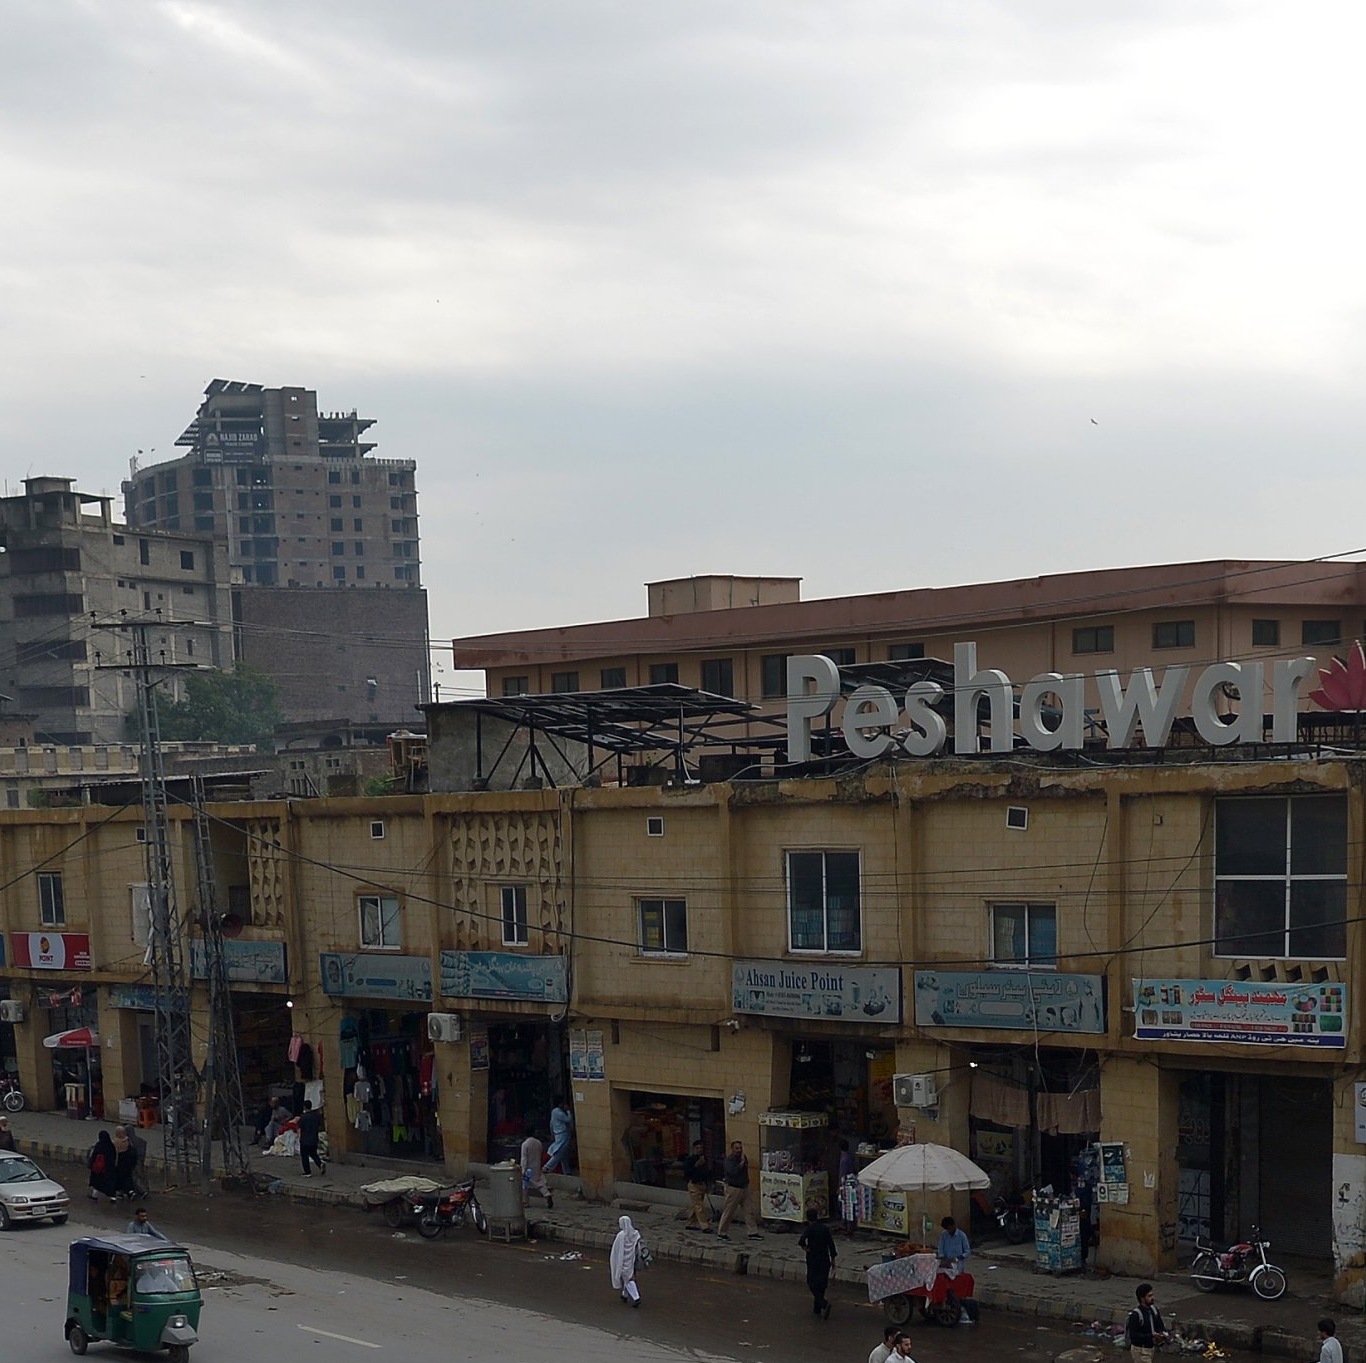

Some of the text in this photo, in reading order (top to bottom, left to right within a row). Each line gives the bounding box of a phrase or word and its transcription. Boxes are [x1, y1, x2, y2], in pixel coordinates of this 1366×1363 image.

[786, 642, 1315, 762] Peshawar
[745, 969, 844, 991] Ahsan Juice Point
